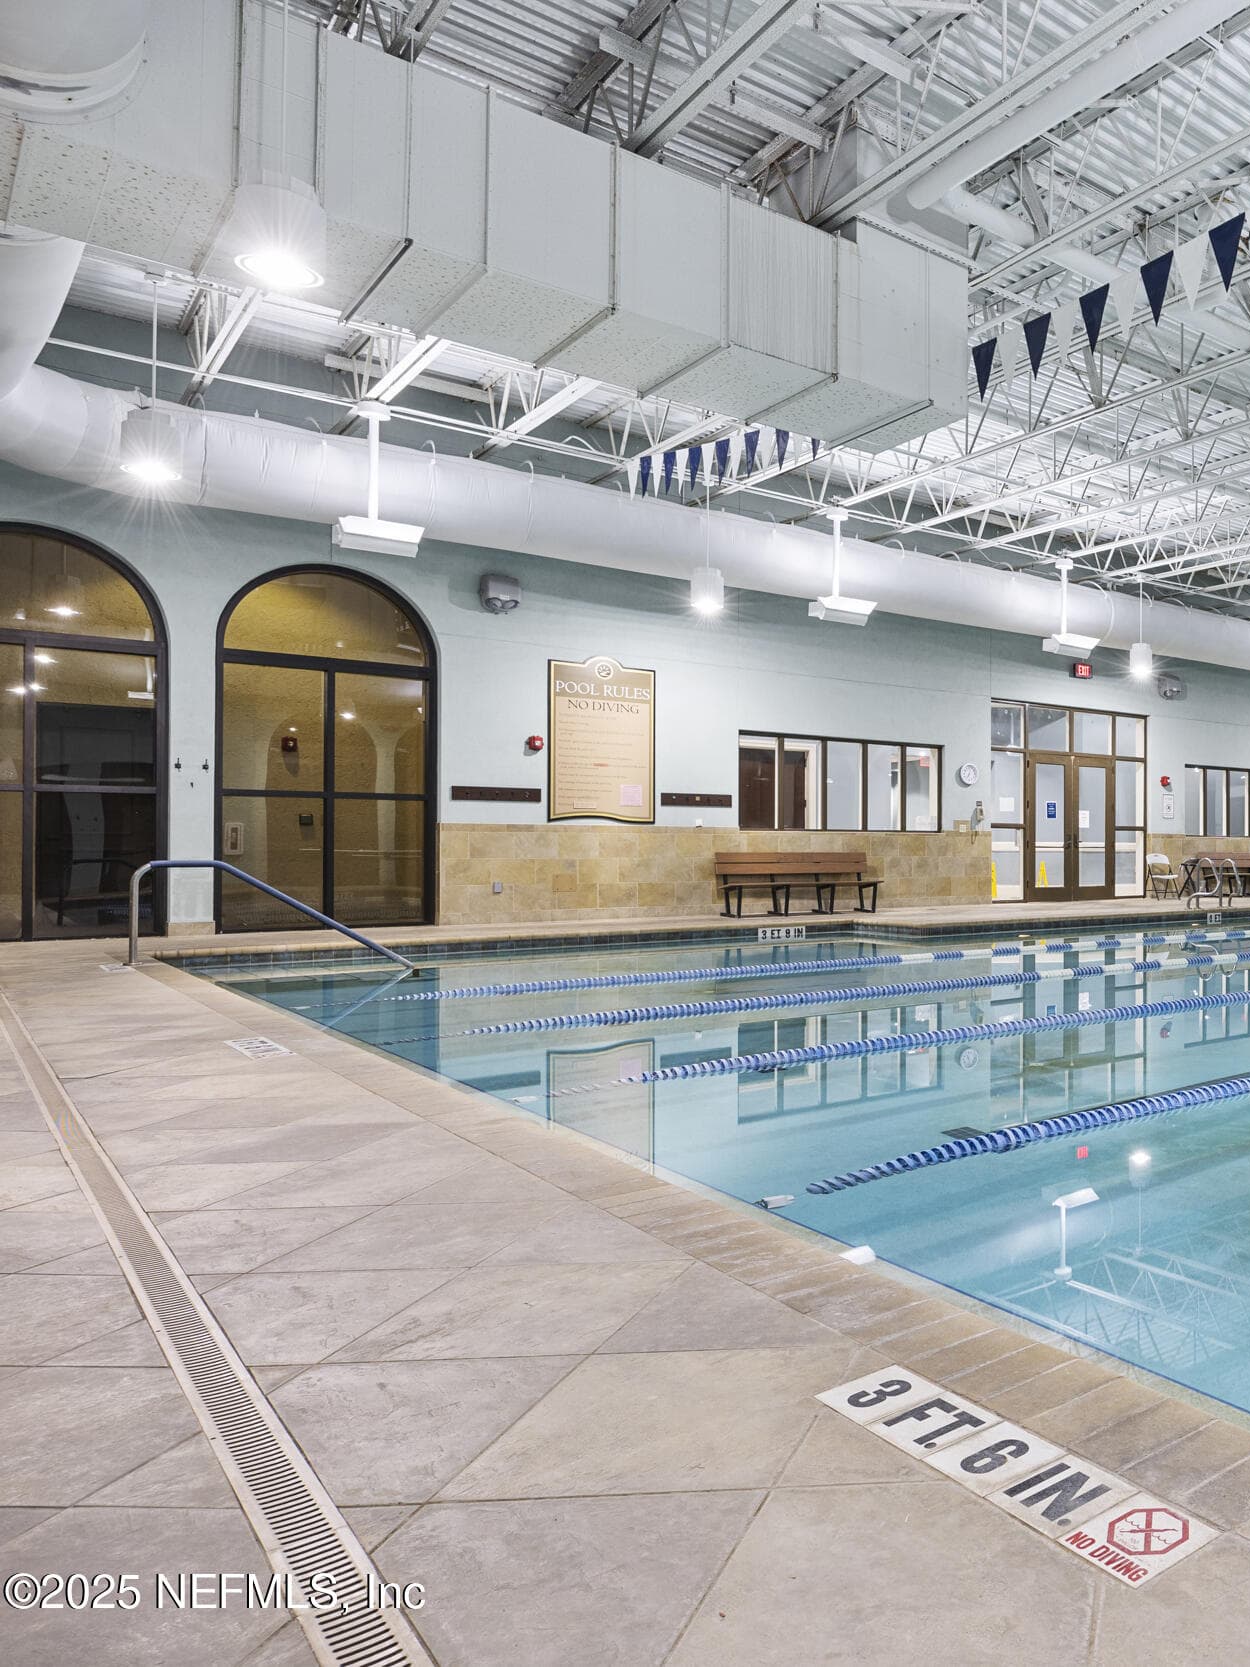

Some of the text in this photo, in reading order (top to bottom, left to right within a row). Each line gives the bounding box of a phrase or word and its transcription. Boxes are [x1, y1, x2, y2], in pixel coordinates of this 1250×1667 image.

[1078, 665, 1091, 677] EXIT
[555, 680, 650, 700] POOL RULES
[567, 699, 640, 715] NO DIVING
[847, 1379, 913, 1409] 3
[960, 1439, 1030, 1475] 6
[1064, 1530, 1097, 1550] NO
[1090, 1545, 1150, 1583] DIVING
